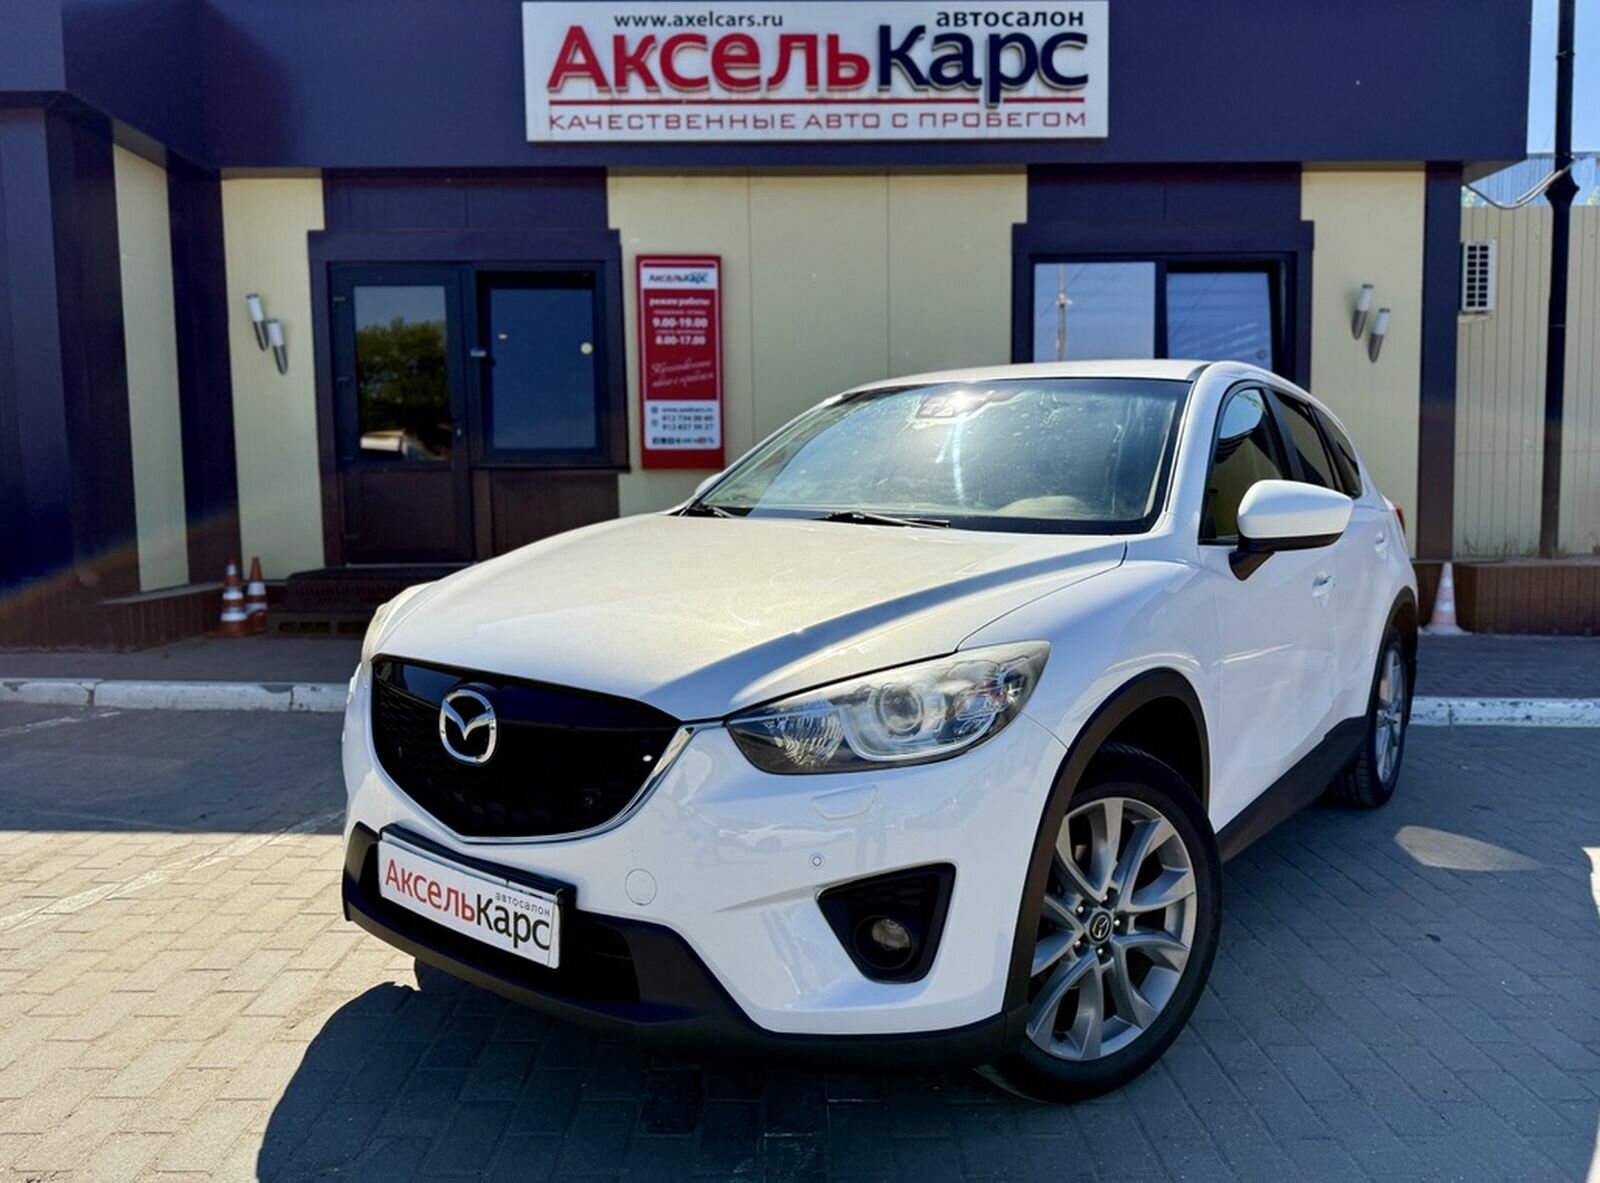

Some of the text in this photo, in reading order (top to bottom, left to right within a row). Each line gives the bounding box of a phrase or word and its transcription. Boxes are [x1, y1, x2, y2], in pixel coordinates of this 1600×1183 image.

[613, 11, 784, 27] www.axelcars.ru
[936, 11, 1084, 27] автосалон
[546, 24, 1089, 109] АксельКарс
[549, 113, 796, 130] КАЧЕСТВЕННЫЕ
[804, 113, 880, 130] АВТО
[919, 111, 1086, 128] ПРОБЕГОМ
[652, 317, 709, 328] 9.00-19.00
[385, 858, 550, 951] АксельКарс
[495, 892, 550, 917] автосалон
